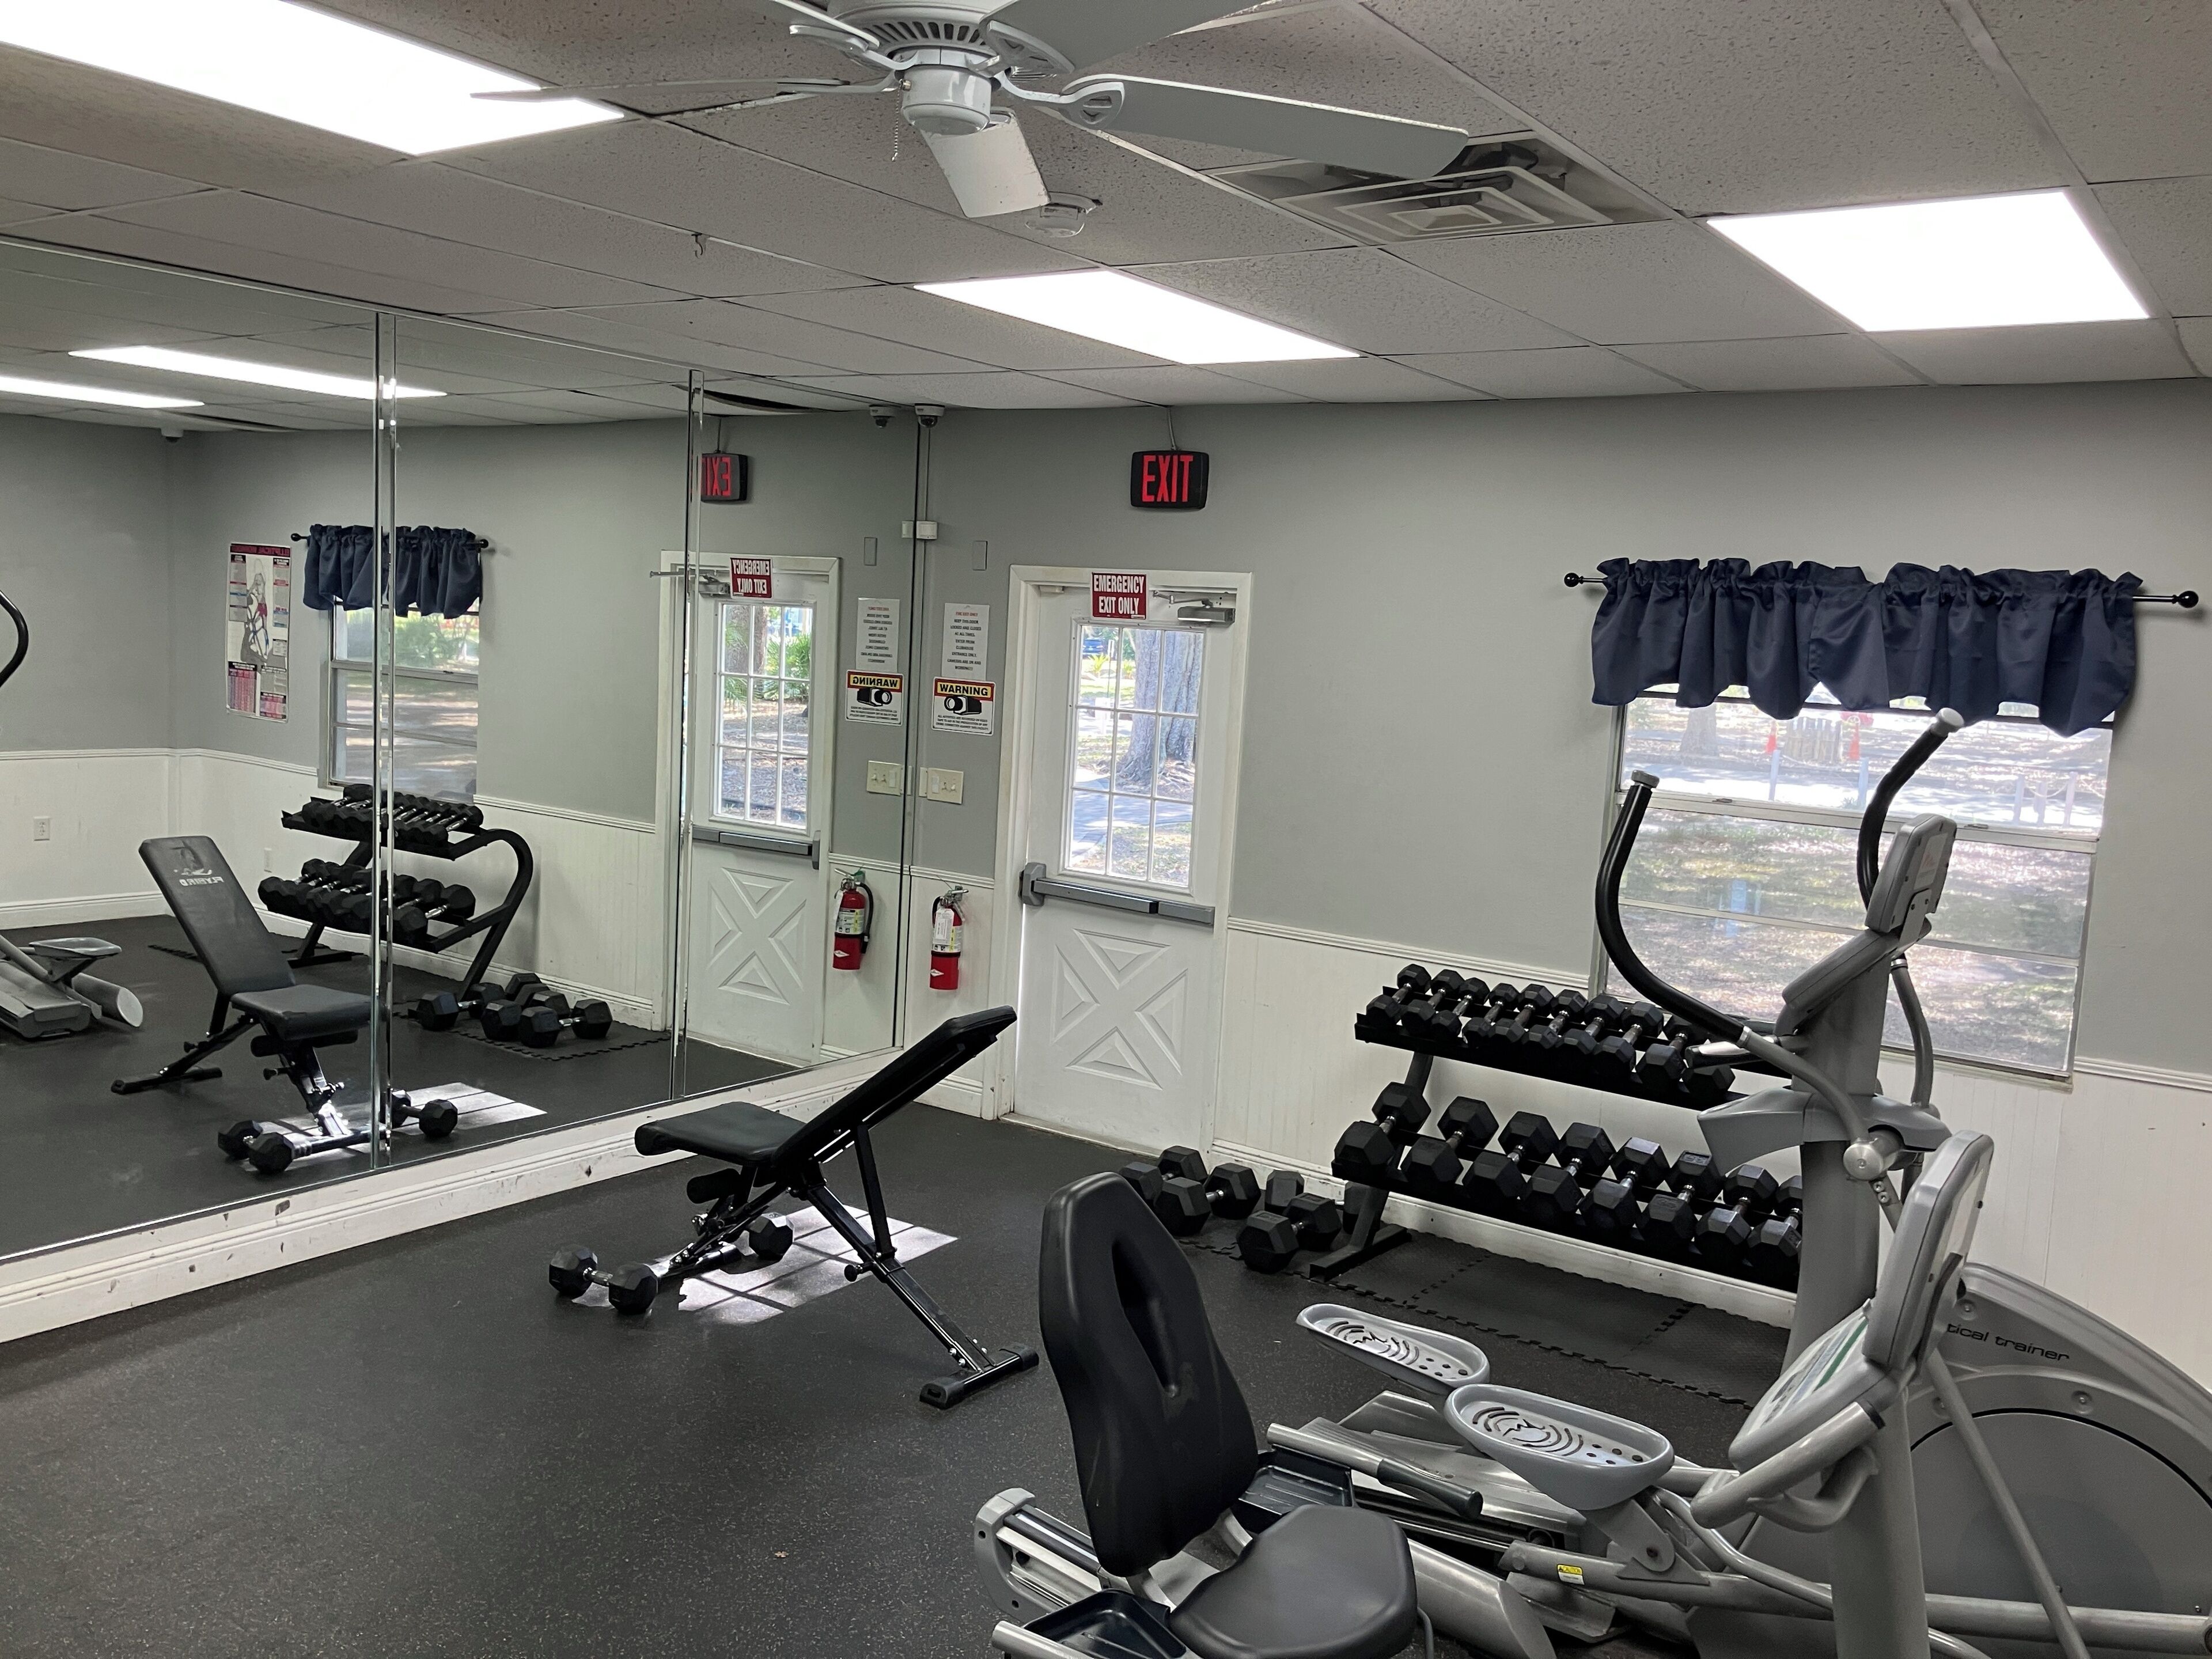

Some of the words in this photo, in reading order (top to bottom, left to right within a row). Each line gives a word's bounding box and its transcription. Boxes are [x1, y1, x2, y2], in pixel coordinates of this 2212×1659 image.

[1142, 455, 1193, 502] EXIT
[1094, 575, 1145, 593] EMERGENCY
[1099, 596, 1116, 613] EXIT
[1118, 597, 1139, 615] ONLY
[940, 684, 988, 696] WARNING
[1995, 1336, 2070, 1361] trainer
